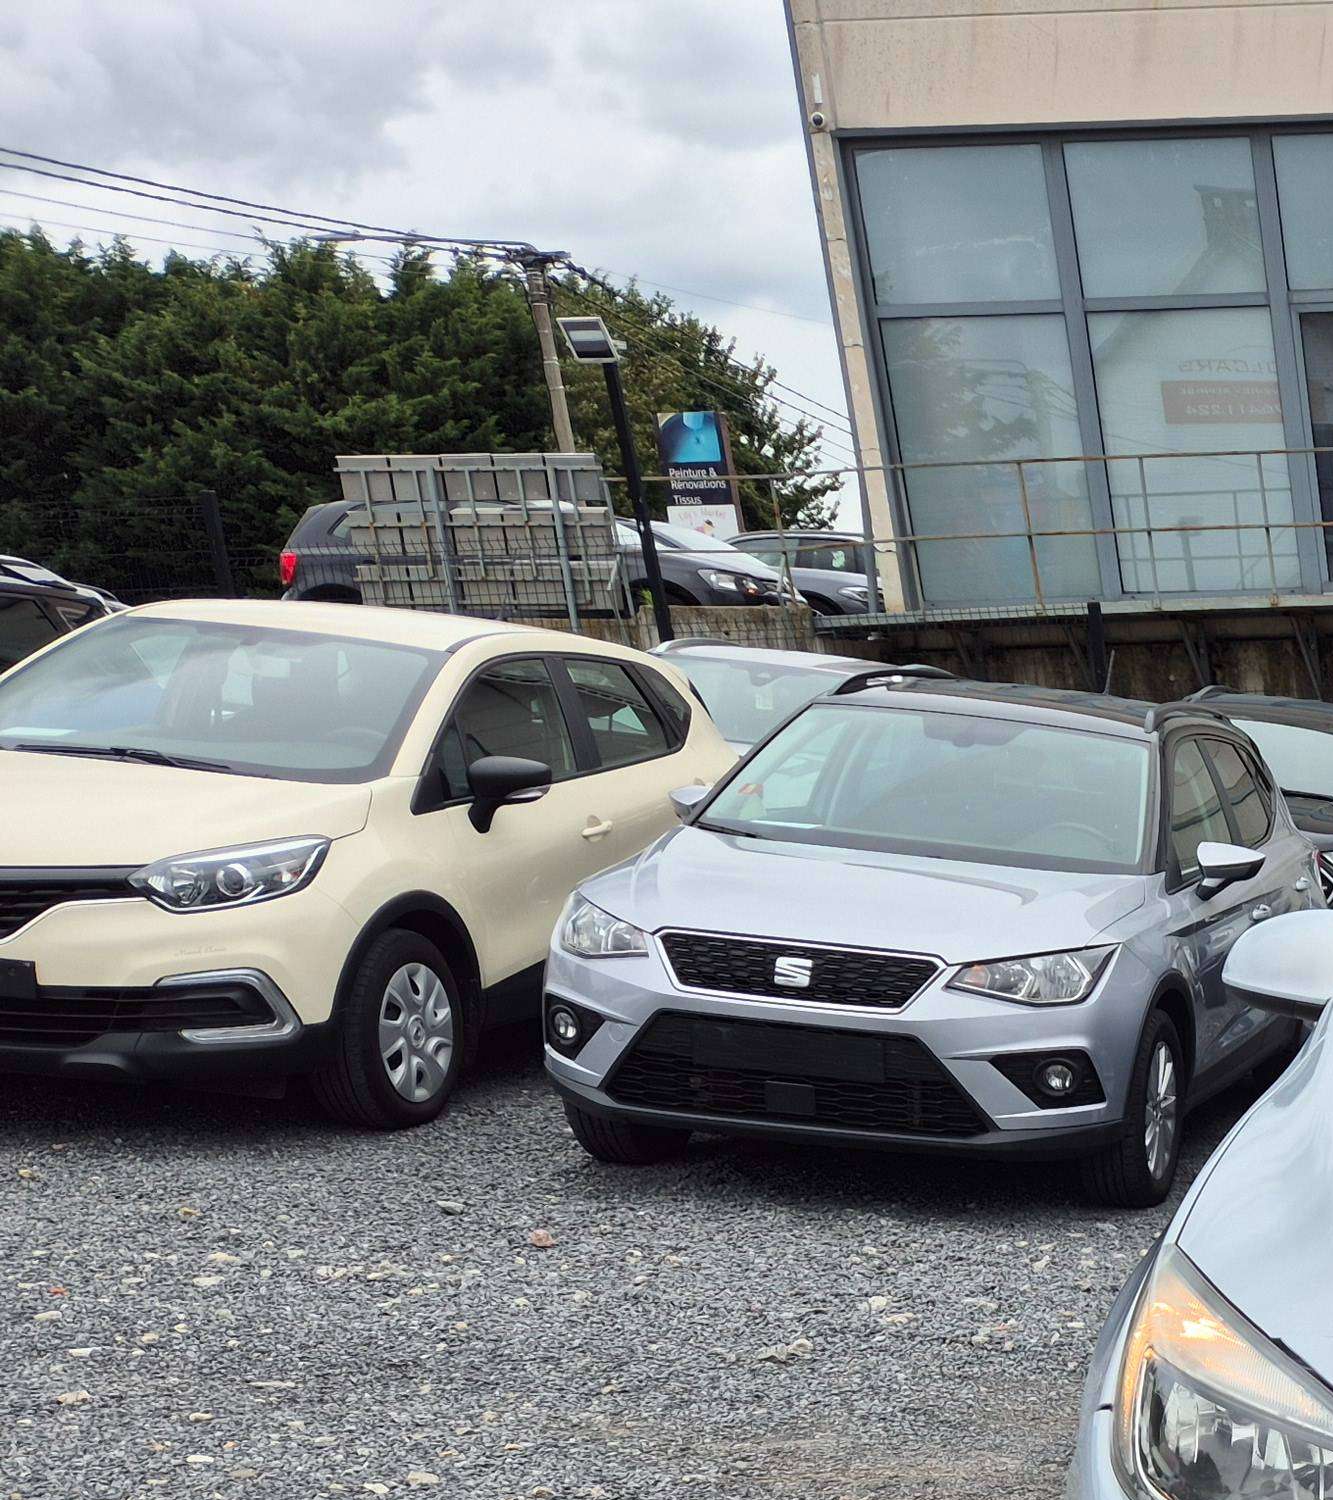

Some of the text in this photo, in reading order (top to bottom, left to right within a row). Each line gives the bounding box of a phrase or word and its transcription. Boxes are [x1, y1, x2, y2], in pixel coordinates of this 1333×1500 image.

[668, 466, 718, 479] Peinture &
[673, 494, 703, 505] Tissus
